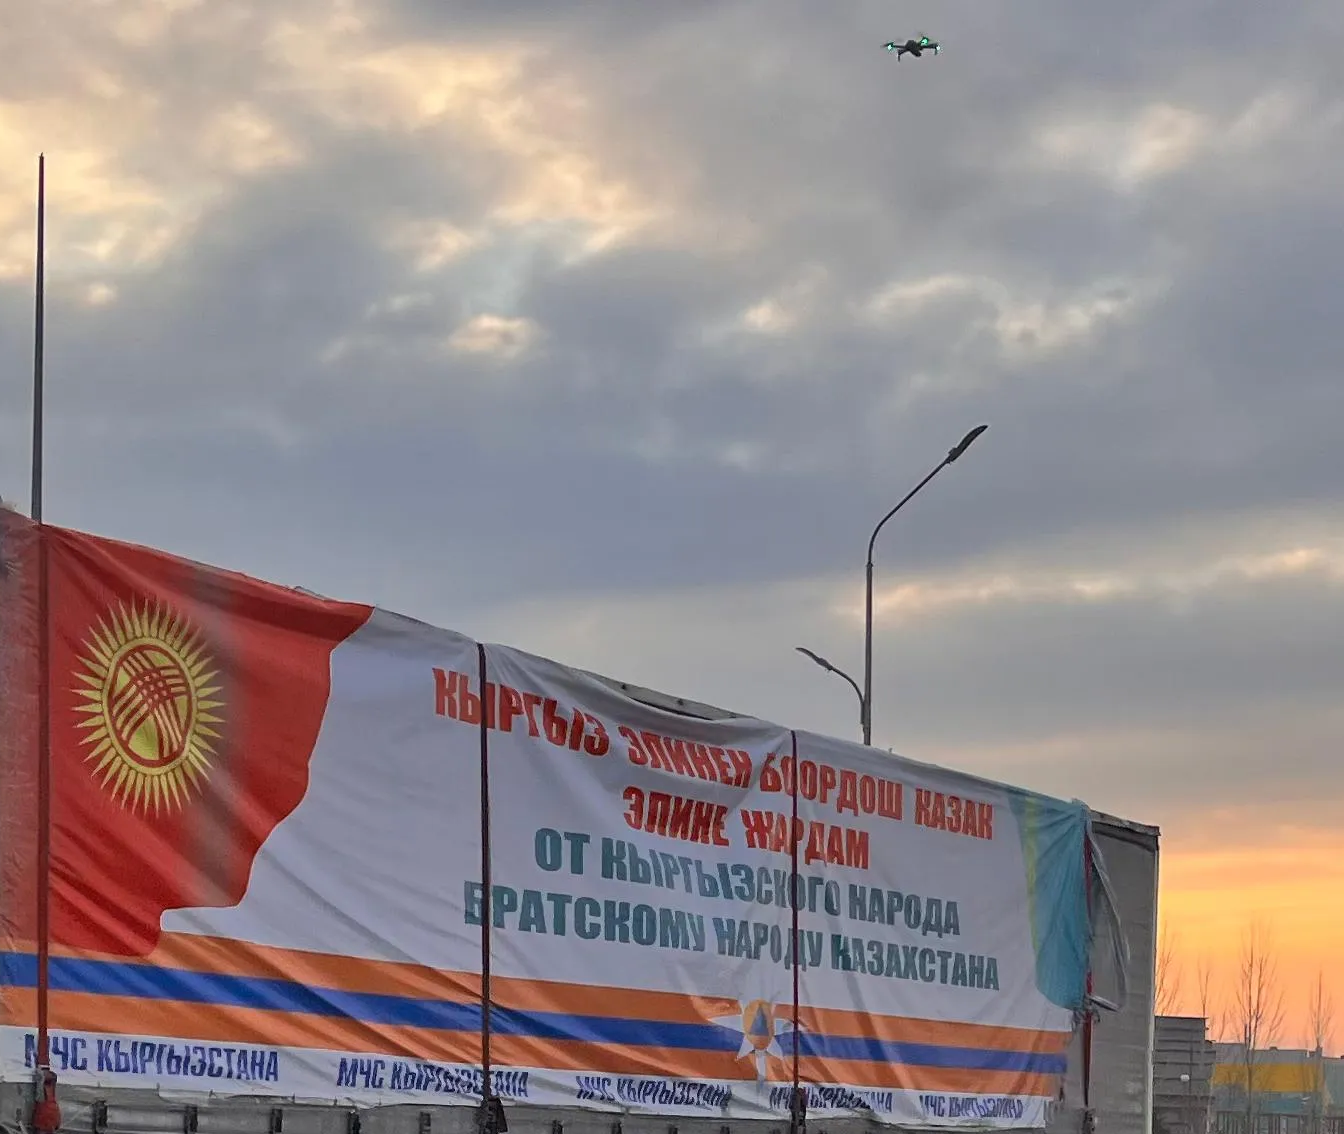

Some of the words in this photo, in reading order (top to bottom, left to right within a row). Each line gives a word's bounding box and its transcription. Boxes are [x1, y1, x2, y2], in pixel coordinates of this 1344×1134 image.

[432, 668, 610, 756] КЫРГЫЗ
[618, 724, 753, 788] ЭЛИНЕН
[760, 752, 903, 820] БООРДОШ
[914, 787, 993, 840] КАЗАК
[623, 786, 729, 846] ЭЛИНЕ
[740, 808, 869, 869] ЖАРДАМ
[535, 827, 590, 875] ОТ
[601, 837, 841, 916] КЫРГЫЗСКОГО
[848, 883, 960, 938] НАРОДА
[463, 880, 705, 952] БРАТСКОМУ
[712, 917, 823, 971] НАРОДУ
[831, 934, 1000, 991] КАЗАХСТАНА
[97, 1039, 279, 1081] КЫРГЫЗСТАНА
[336, 1057, 386, 1089] МЧС
